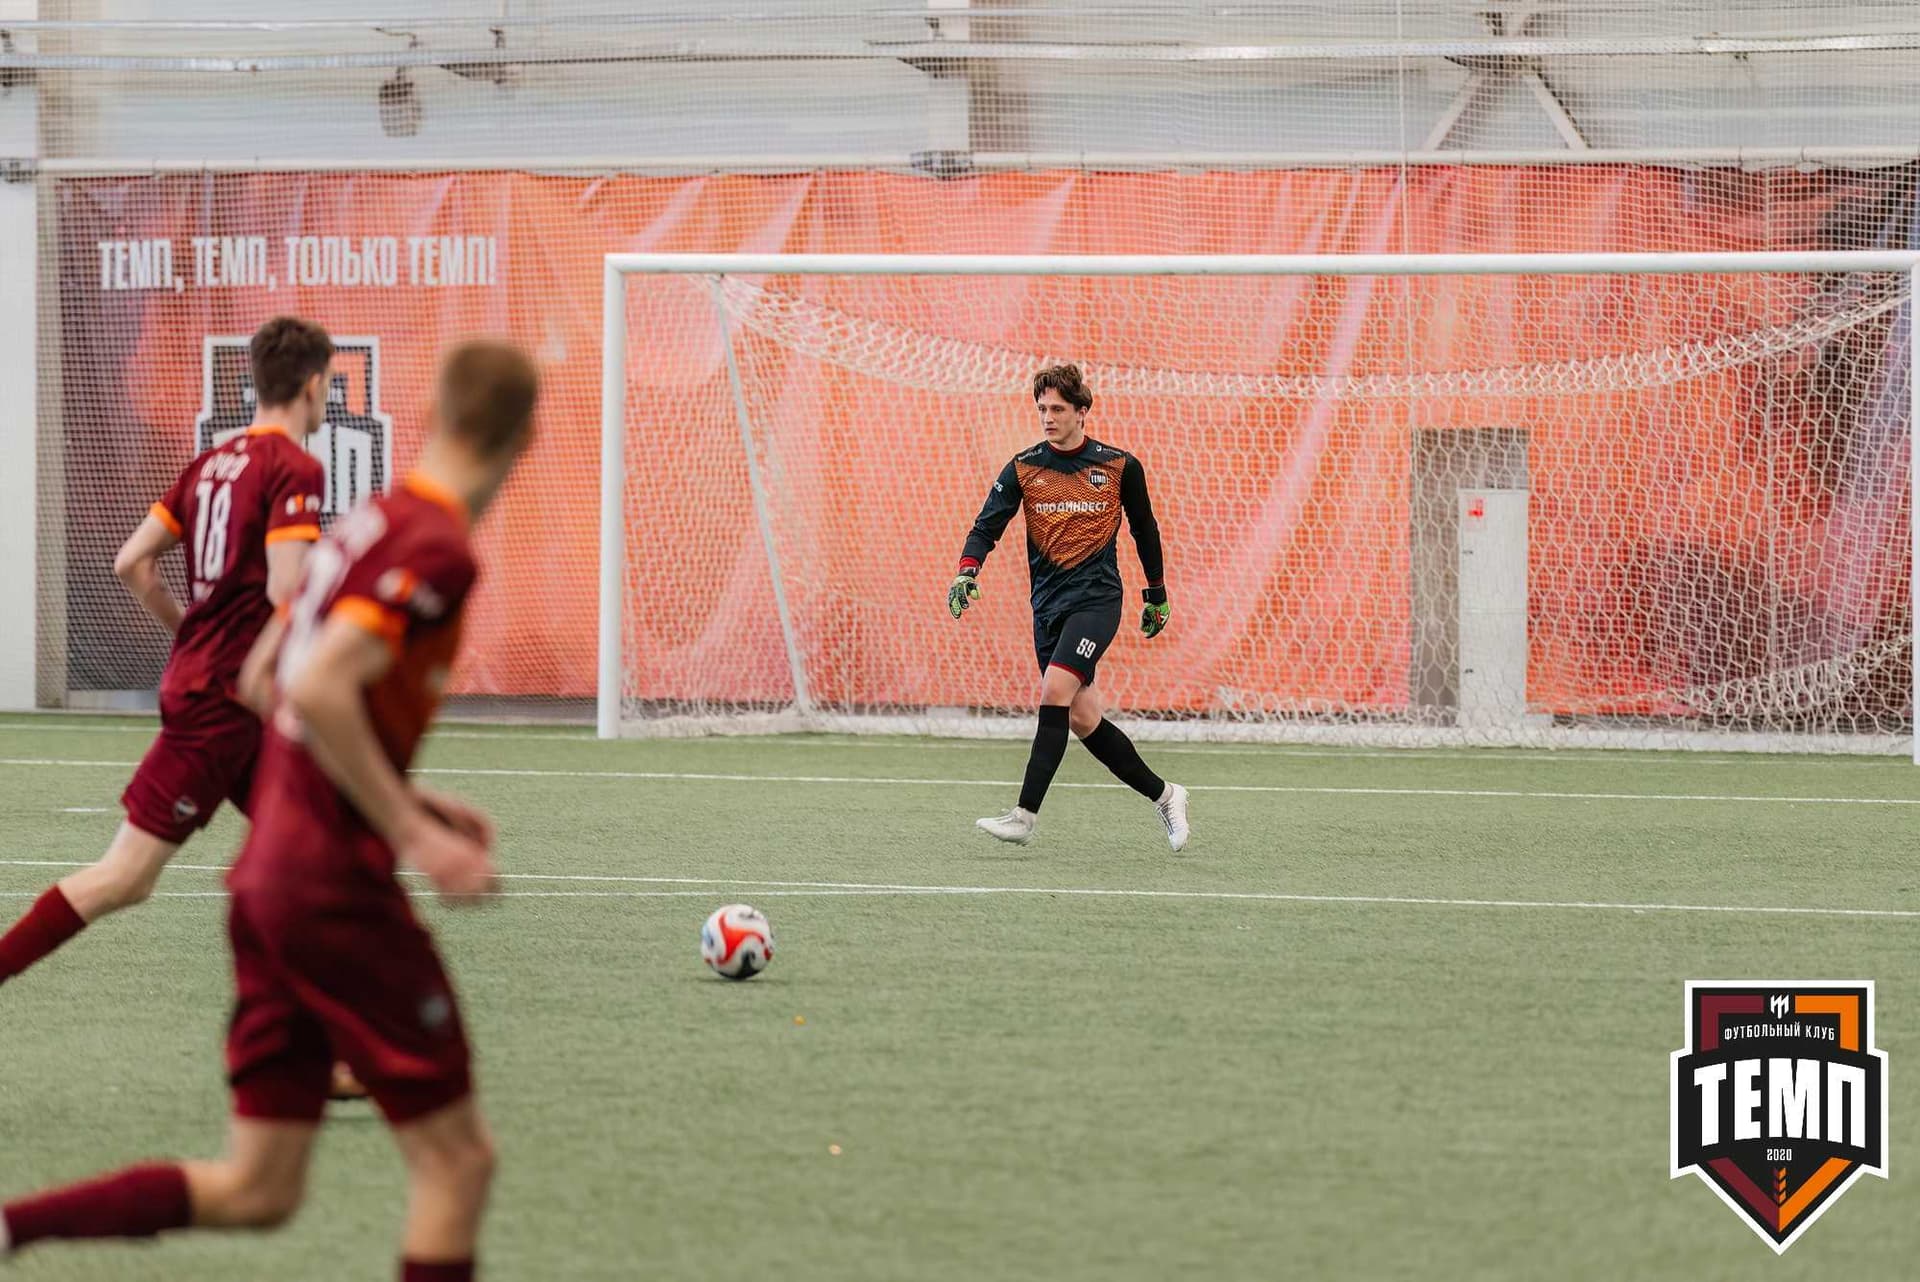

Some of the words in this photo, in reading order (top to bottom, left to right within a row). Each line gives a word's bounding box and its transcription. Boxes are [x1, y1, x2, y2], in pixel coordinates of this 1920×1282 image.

[98, 239, 184, 293] ТЕМП,
[192, 236, 277, 292] ТЕМП,
[285, 236, 397, 286] ТОЛЬКО
[409, 236, 496, 286] ТЕМП!
[194, 480, 232, 581] 18
